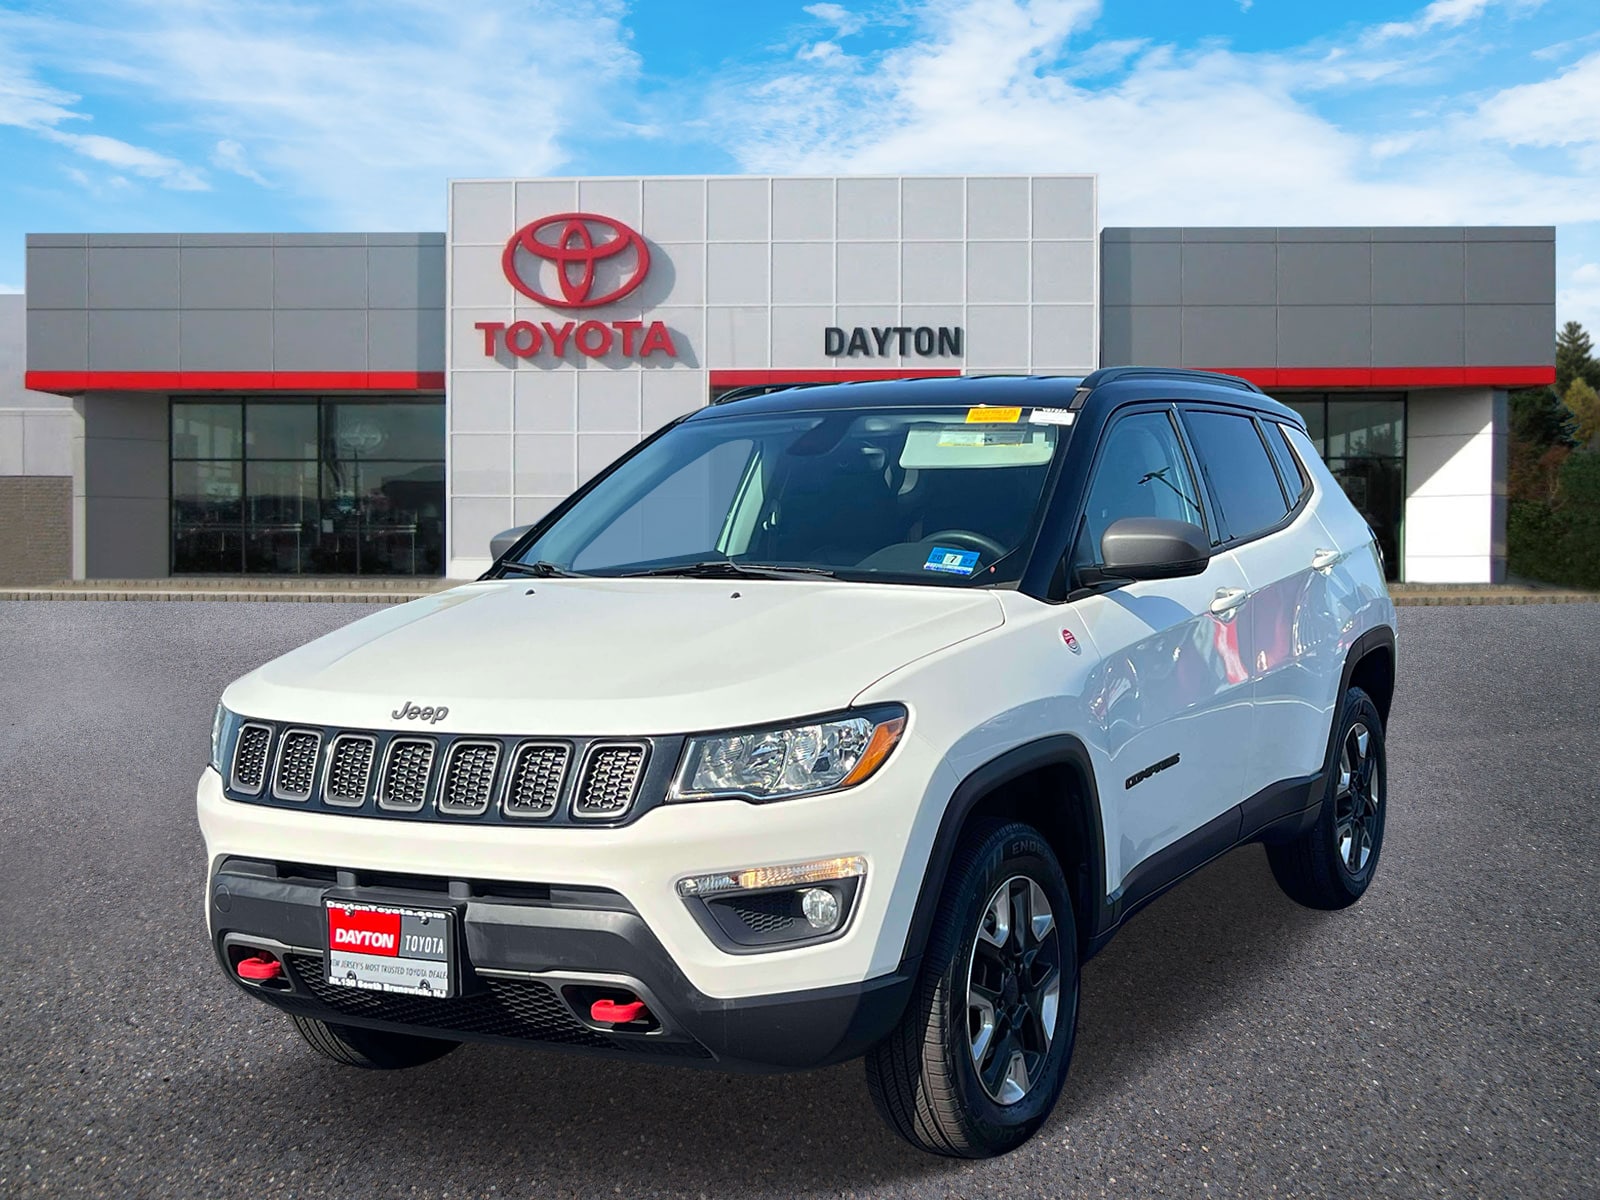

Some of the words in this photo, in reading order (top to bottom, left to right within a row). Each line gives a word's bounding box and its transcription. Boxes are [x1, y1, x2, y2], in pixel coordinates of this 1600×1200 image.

[475, 321, 677, 357] TOYOTA
[825, 326, 962, 357] DAYTON
[950, 555, 957, 563] 7
[391, 701, 449, 724] Jeep
[326, 900, 446, 918] DaytonToyota.com
[335, 928, 394, 948] DAYTON
[405, 935, 444, 954] TOYOTA
[365, 963, 380, 972] MOST
[381, 964, 405, 975] TRUSTED
[406, 967, 427, 977] TOYOTA
[428, 970, 447, 979] DEALE
[357, 980, 382, 990] South
[433, 989, 446, 998] NJ
